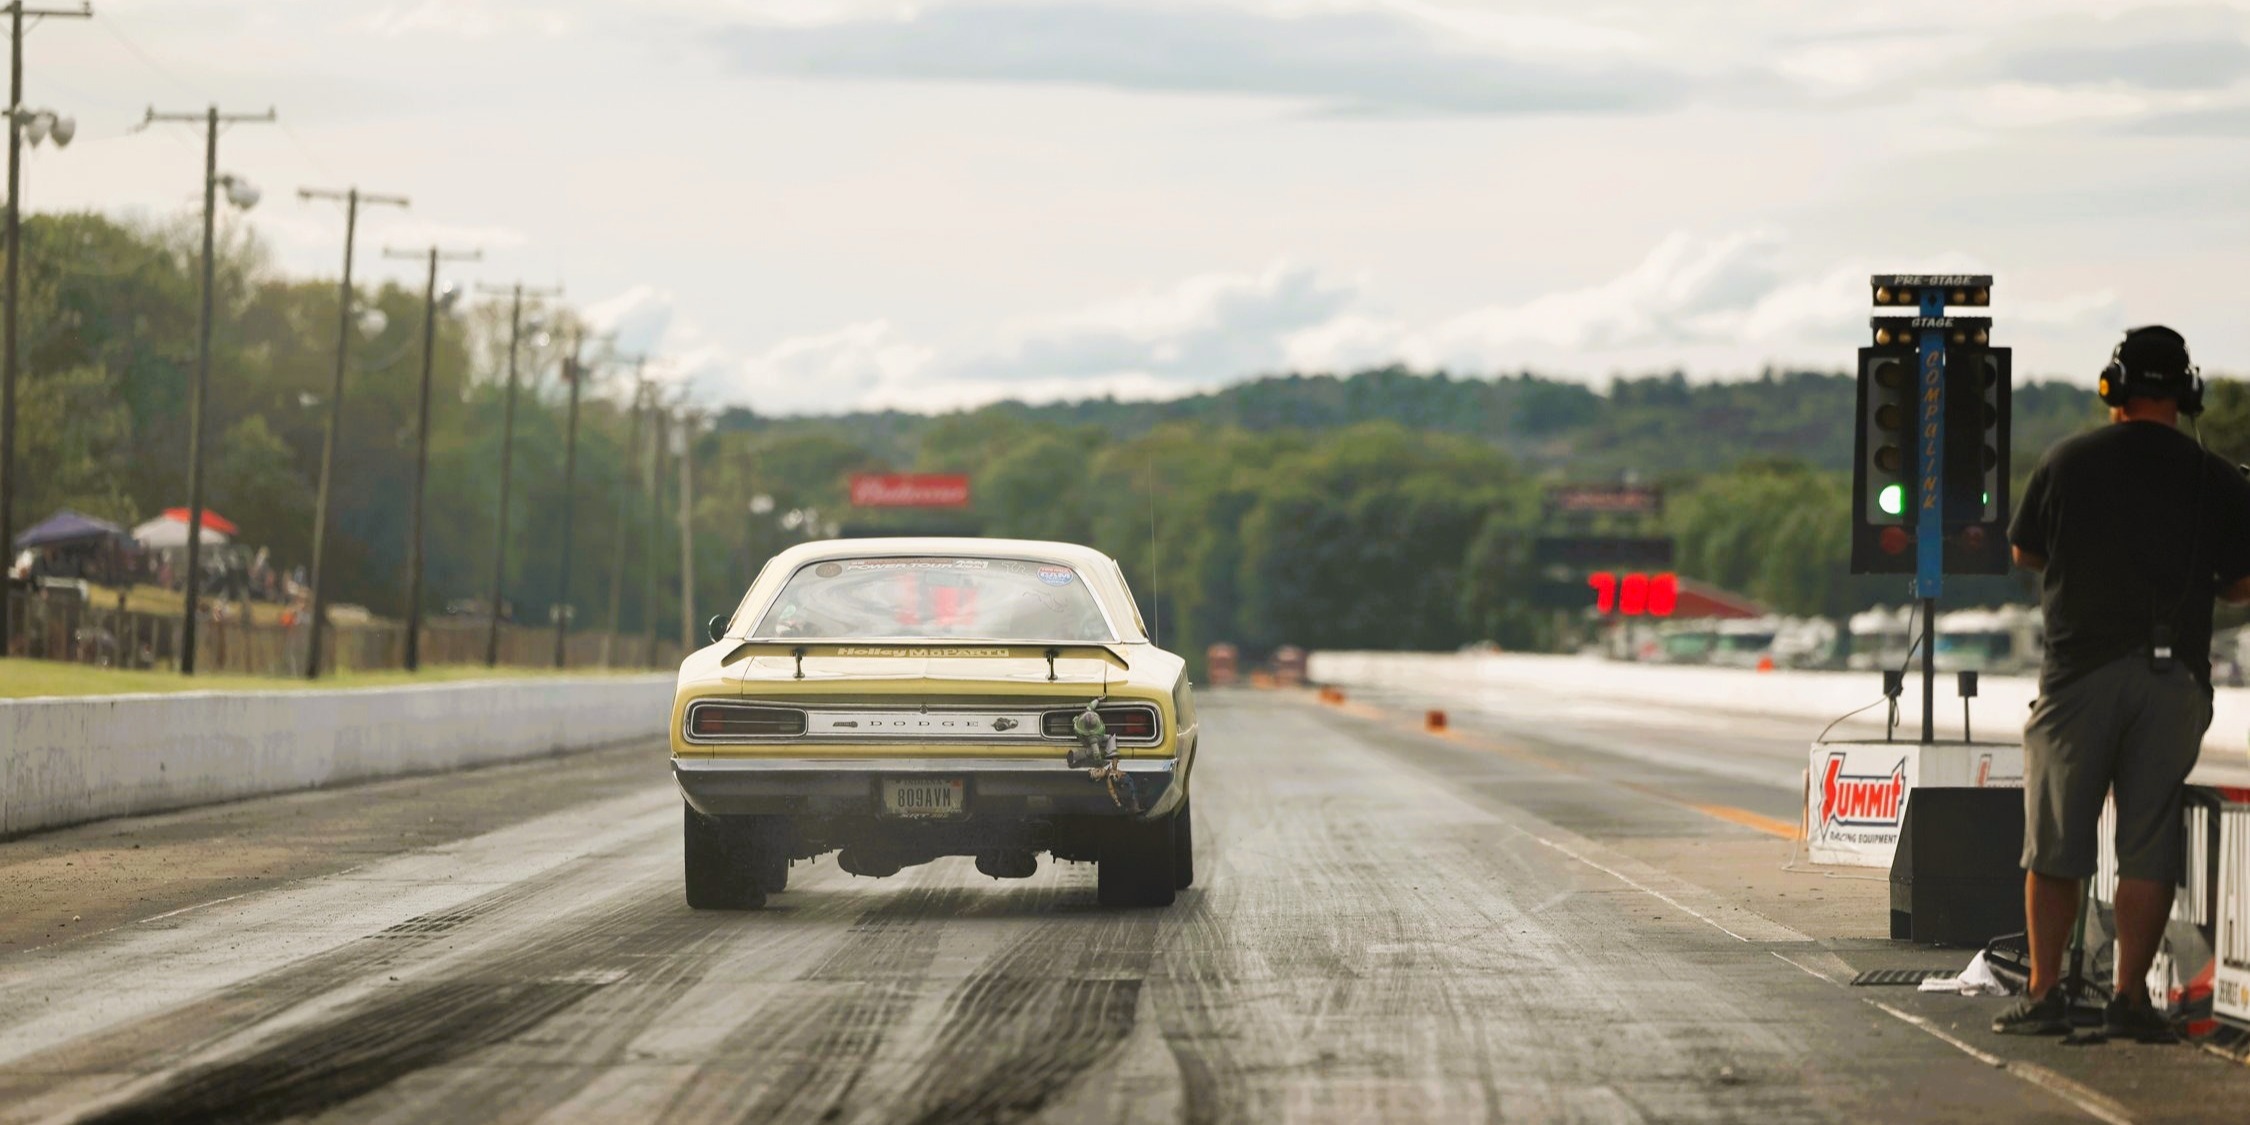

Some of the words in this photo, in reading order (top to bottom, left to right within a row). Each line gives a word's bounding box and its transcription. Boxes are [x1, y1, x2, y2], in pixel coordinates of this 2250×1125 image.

[1894, 275, 1972, 286] PRE-STAGE
[1911, 317, 1954, 328] STAGE
[1923, 350, 1940, 510] COMPULINK
[848, 562, 908, 571] POWER
[911, 562, 953, 570] TOUR
[837, 647, 907, 658] Holley
[897, 787, 951, 808] 809AVM
[1820, 757, 1903, 829] SUMMIT
[1830, 831, 1857, 843] RACING
[1859, 834, 1898, 844] EQUIPMENT
